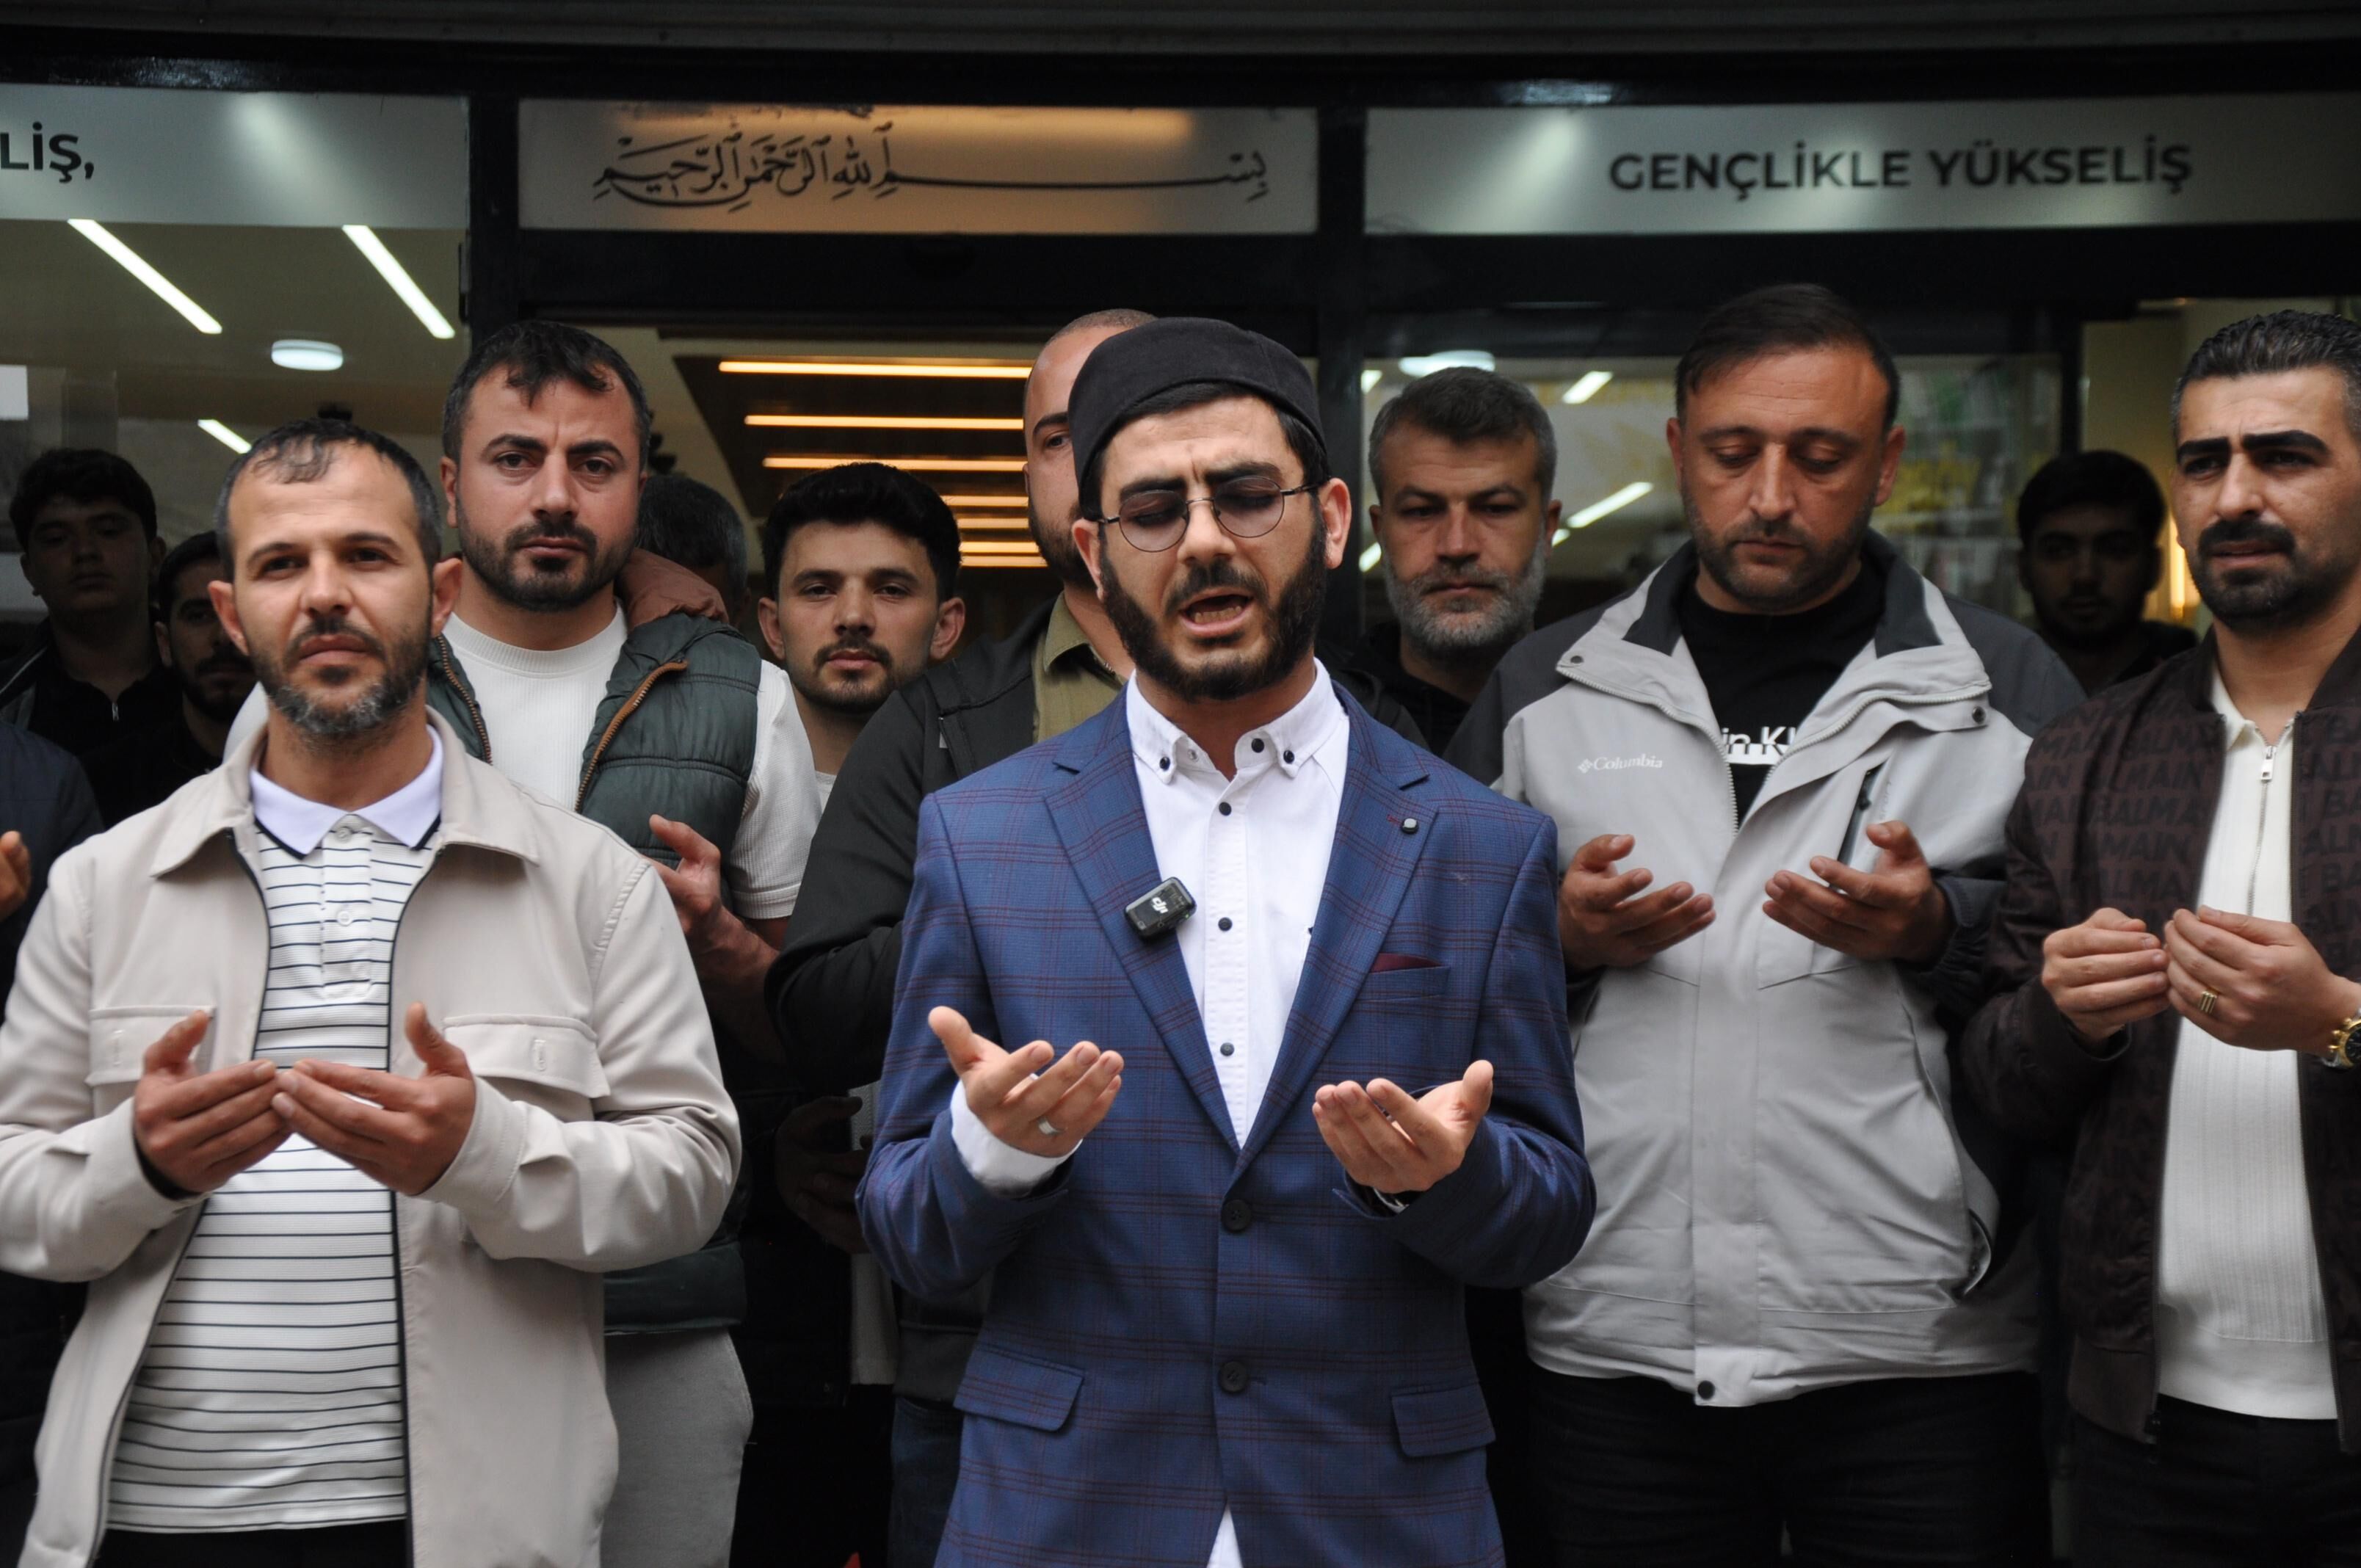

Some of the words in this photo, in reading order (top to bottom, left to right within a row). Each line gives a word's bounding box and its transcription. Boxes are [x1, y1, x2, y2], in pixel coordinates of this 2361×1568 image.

[1610, 140, 1911, 201] GENÇLİKLE
[1928, 134, 2191, 195] YÜKSELİŞ
[1593, 753, 1663, 771] Columbia
